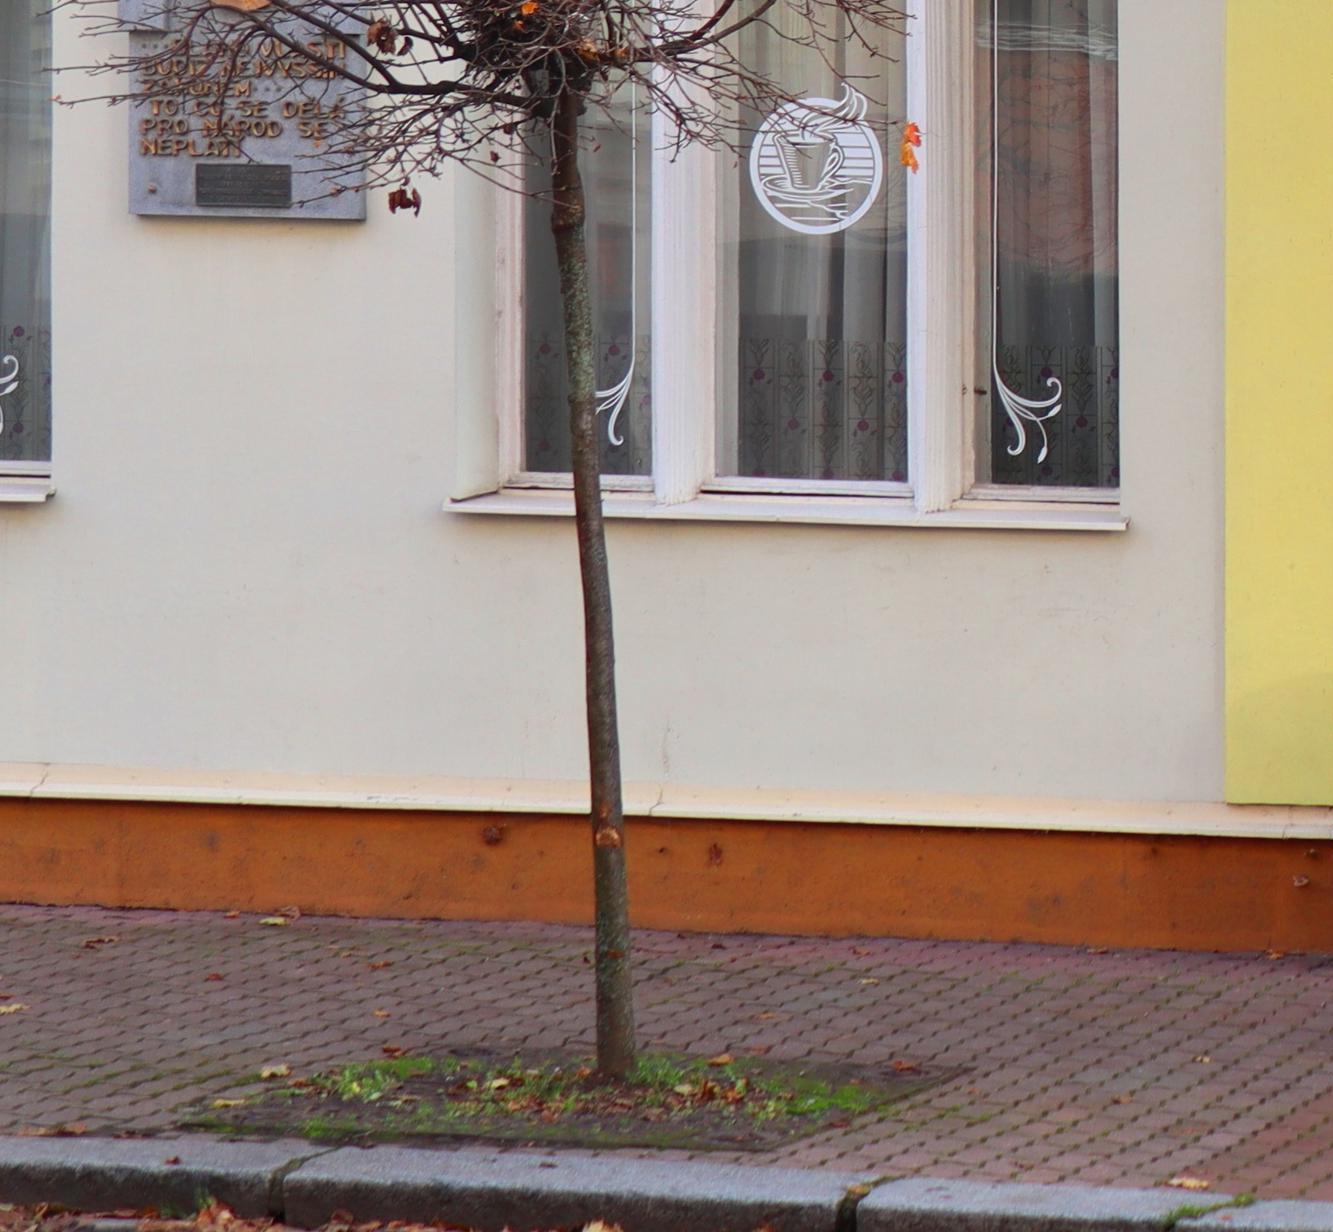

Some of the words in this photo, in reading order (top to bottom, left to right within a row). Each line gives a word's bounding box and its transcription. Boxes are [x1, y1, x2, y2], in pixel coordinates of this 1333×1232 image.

[150, 99, 180, 116] TO
[237, 99, 269, 117] SE
[140, 119, 189, 136] PRO
[298, 122, 329, 138] SE
